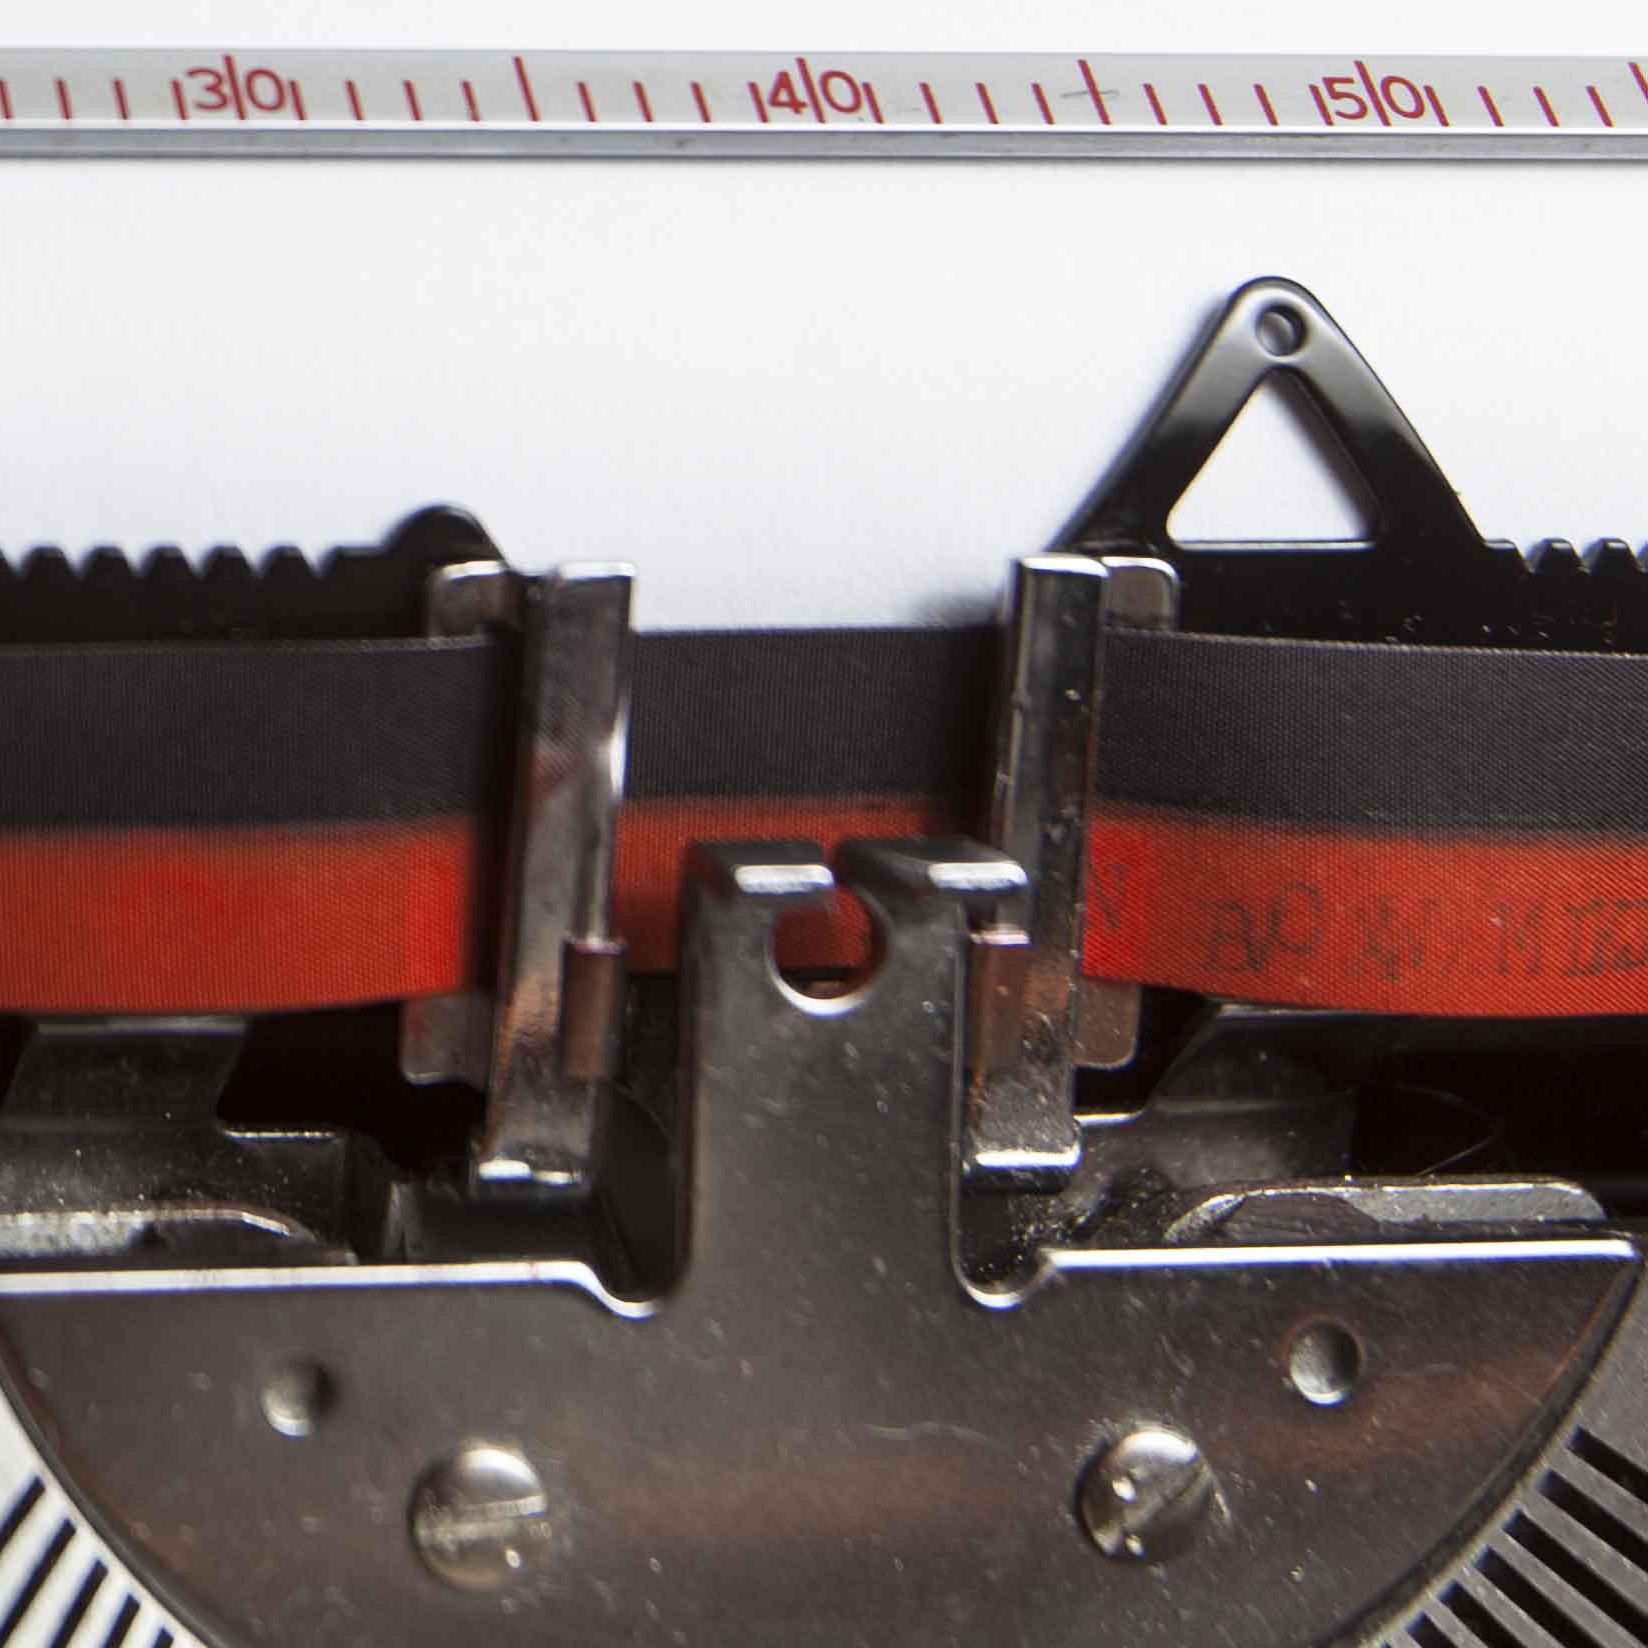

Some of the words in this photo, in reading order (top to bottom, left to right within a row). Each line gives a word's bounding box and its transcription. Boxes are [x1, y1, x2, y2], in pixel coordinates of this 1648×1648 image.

[188, 67, 287, 112] 30
[768, 68, 863, 117] 40
[1325, 74, 1427, 121] 50
